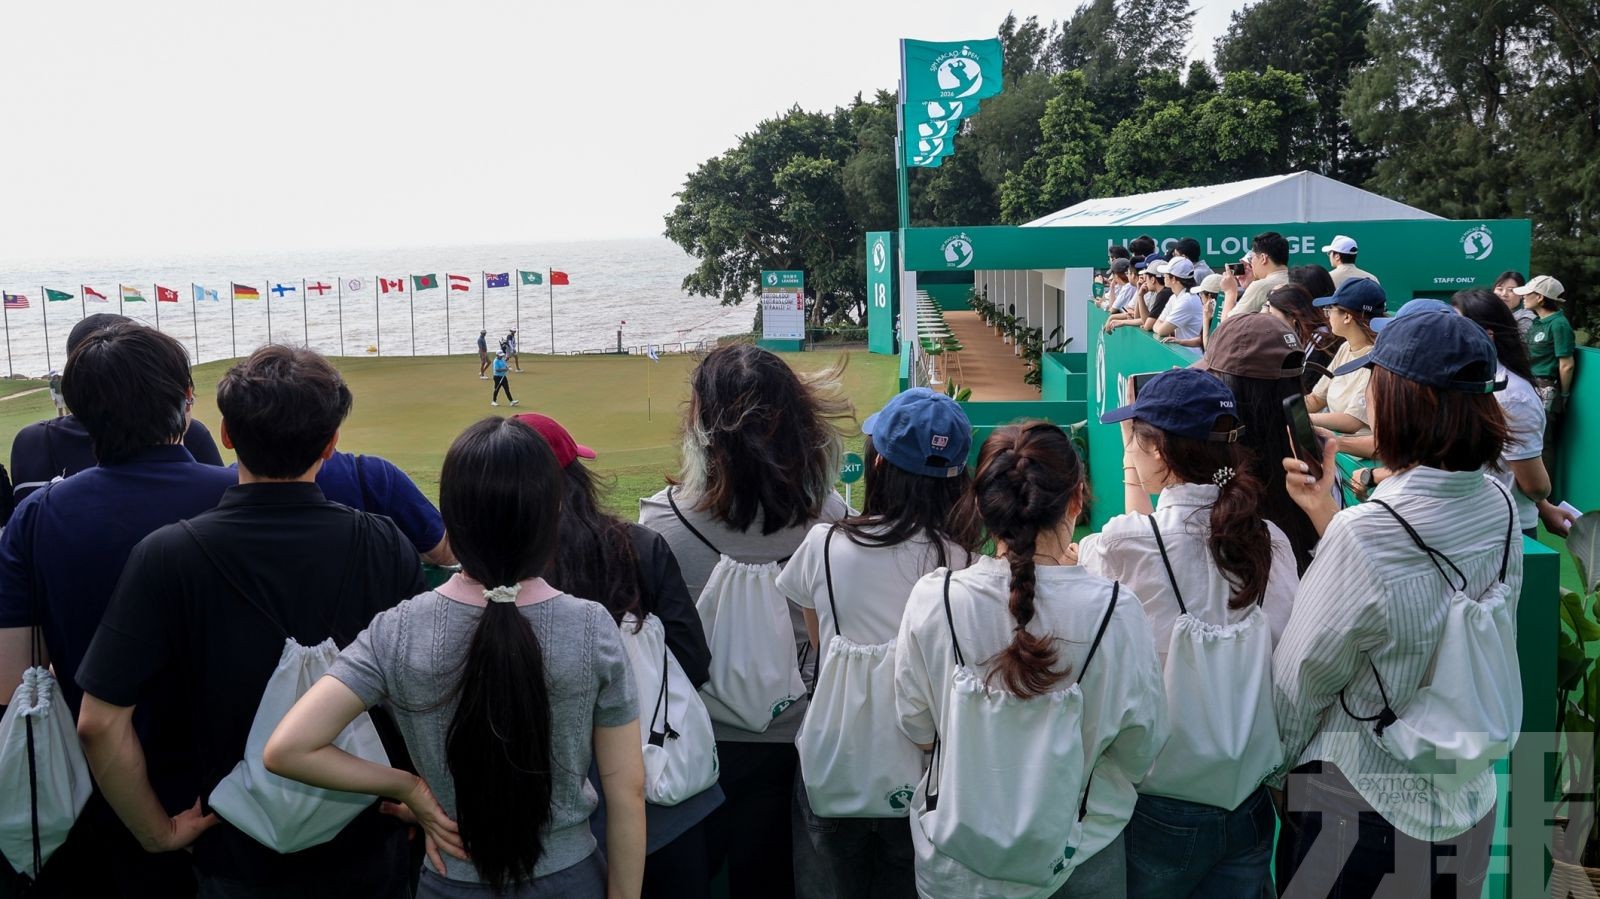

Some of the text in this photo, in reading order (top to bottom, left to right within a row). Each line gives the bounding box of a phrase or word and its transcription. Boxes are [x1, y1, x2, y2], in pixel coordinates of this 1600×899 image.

[937, 51, 959, 61] MACAO
[961, 46, 979, 60] OPEN
[1206, 236, 1316, 255] LOUGE
[874, 282, 886, 308] 18
